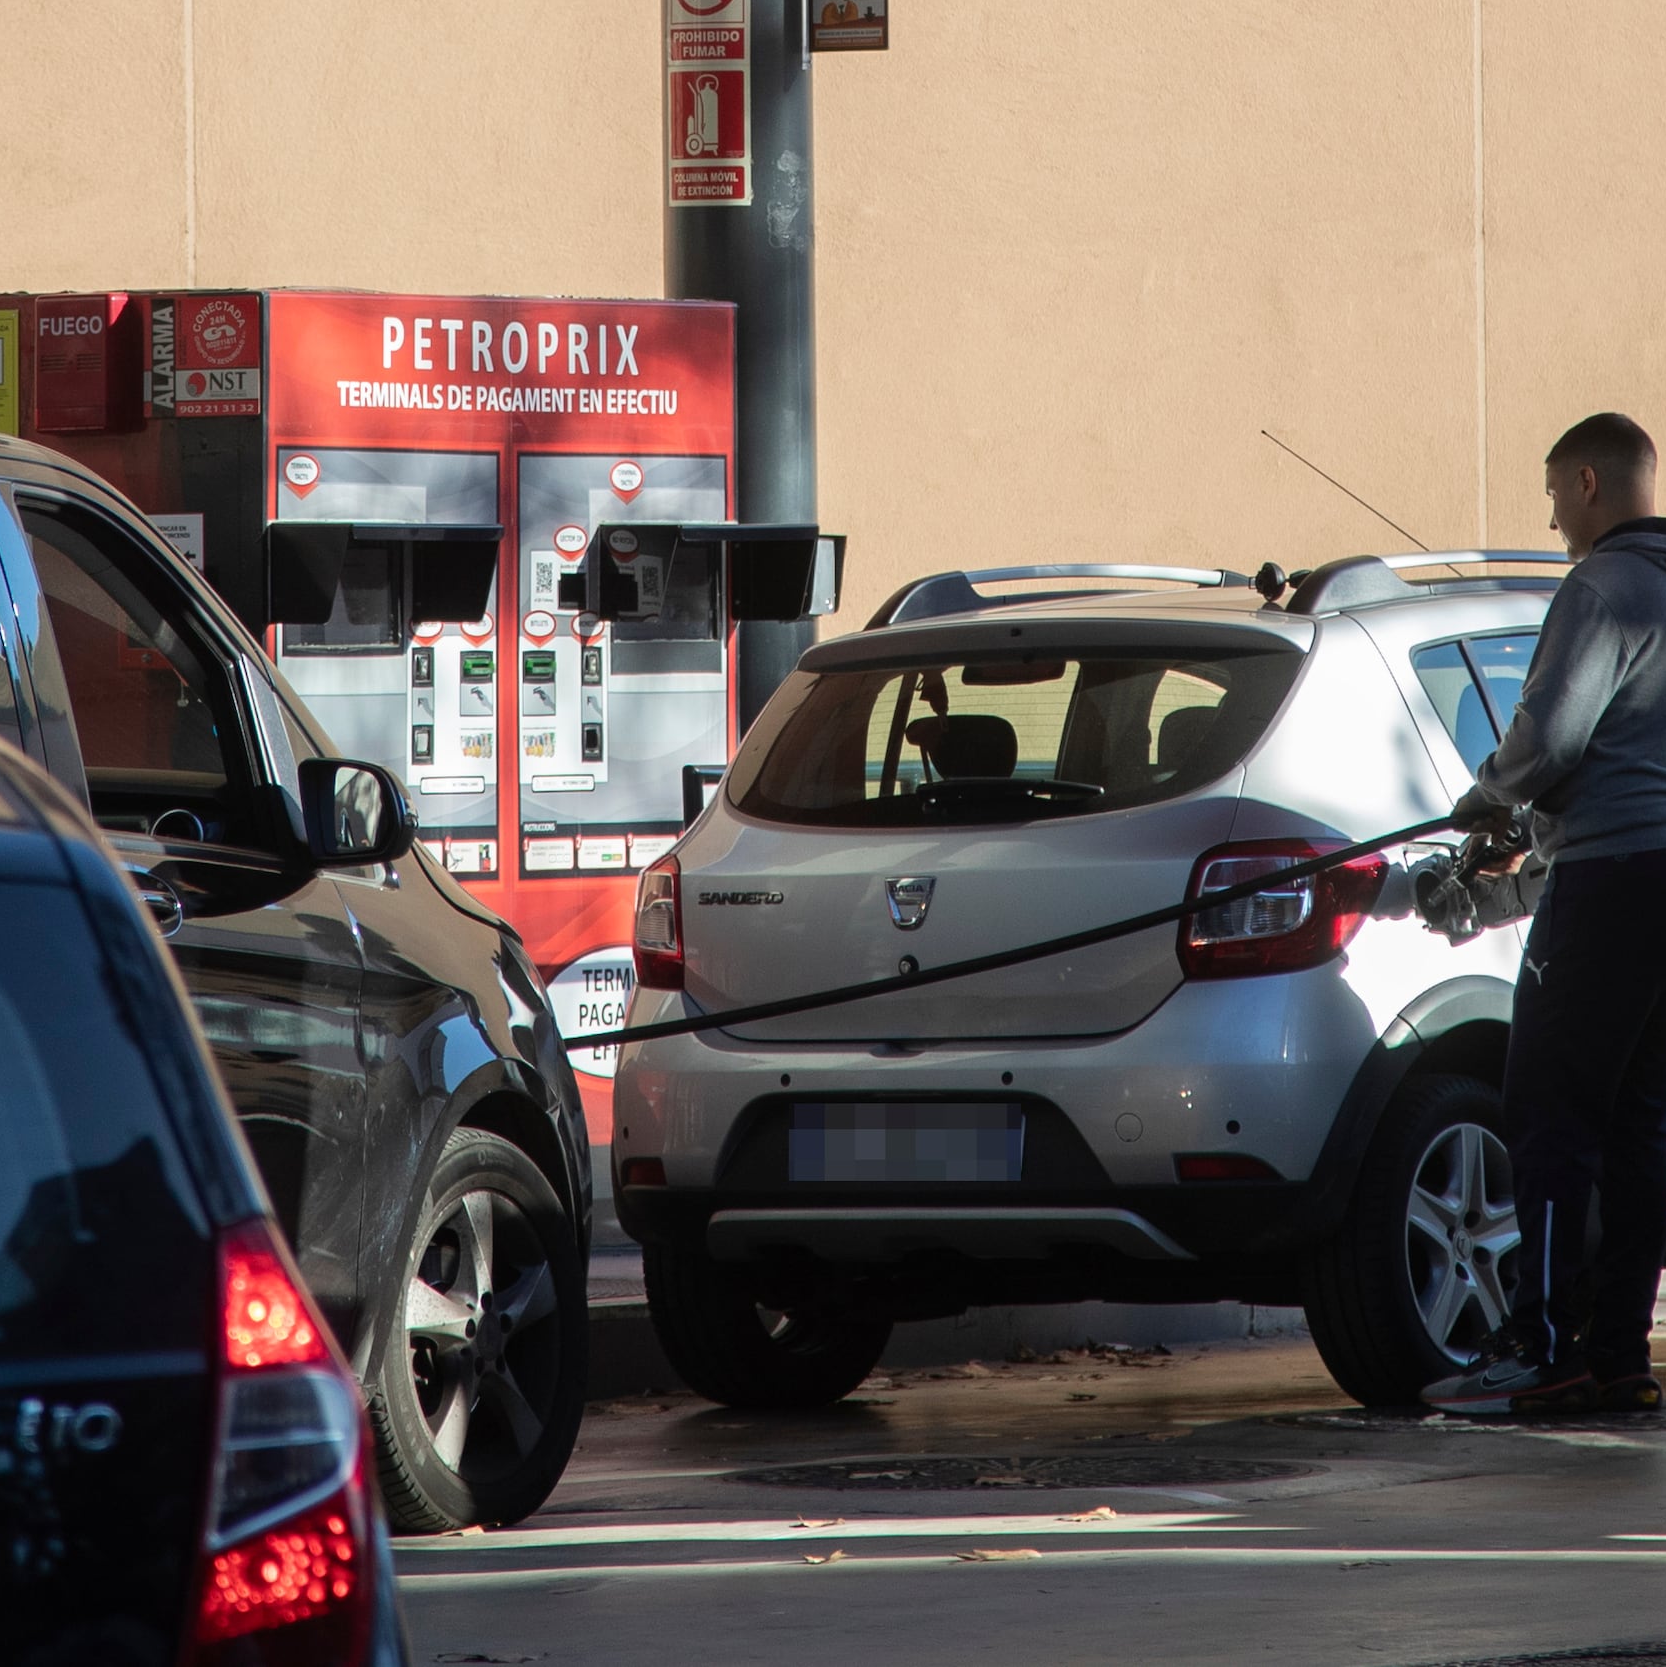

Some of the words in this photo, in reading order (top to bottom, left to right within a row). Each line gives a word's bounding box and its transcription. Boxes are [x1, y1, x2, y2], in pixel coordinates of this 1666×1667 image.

[673, 31, 740, 43] PROHIBIDO
[683, 46, 726, 57] FUMAR
[674, 173, 709, 183] COLUMNA
[710, 170, 739, 182] MÓVIL
[678, 186, 687, 196] DE
[688, 183, 733, 196] EXTINCIÓN
[193, 300, 246, 333] CONECTADA
[209, 315, 226, 325] 24H
[39, 316, 103, 336] FUEGO
[383, 317, 639, 376] PETROPRIX
[152, 306, 175, 409] ALARMA
[209, 371, 247, 391] NST
[337, 381, 443, 410] TERMINALS
[448, 386, 472, 410] DE
[476, 387, 575, 413] PAGAMENT
[579, 389, 603, 413] EN
[607, 389, 678, 415] EFECTIU
[180, 405, 202, 413] 902
[205, 405, 218, 413] 21
[222, 405, 236, 413] 31
[240, 404, 254, 412] 32
[698, 891, 784, 906] SANDERO
